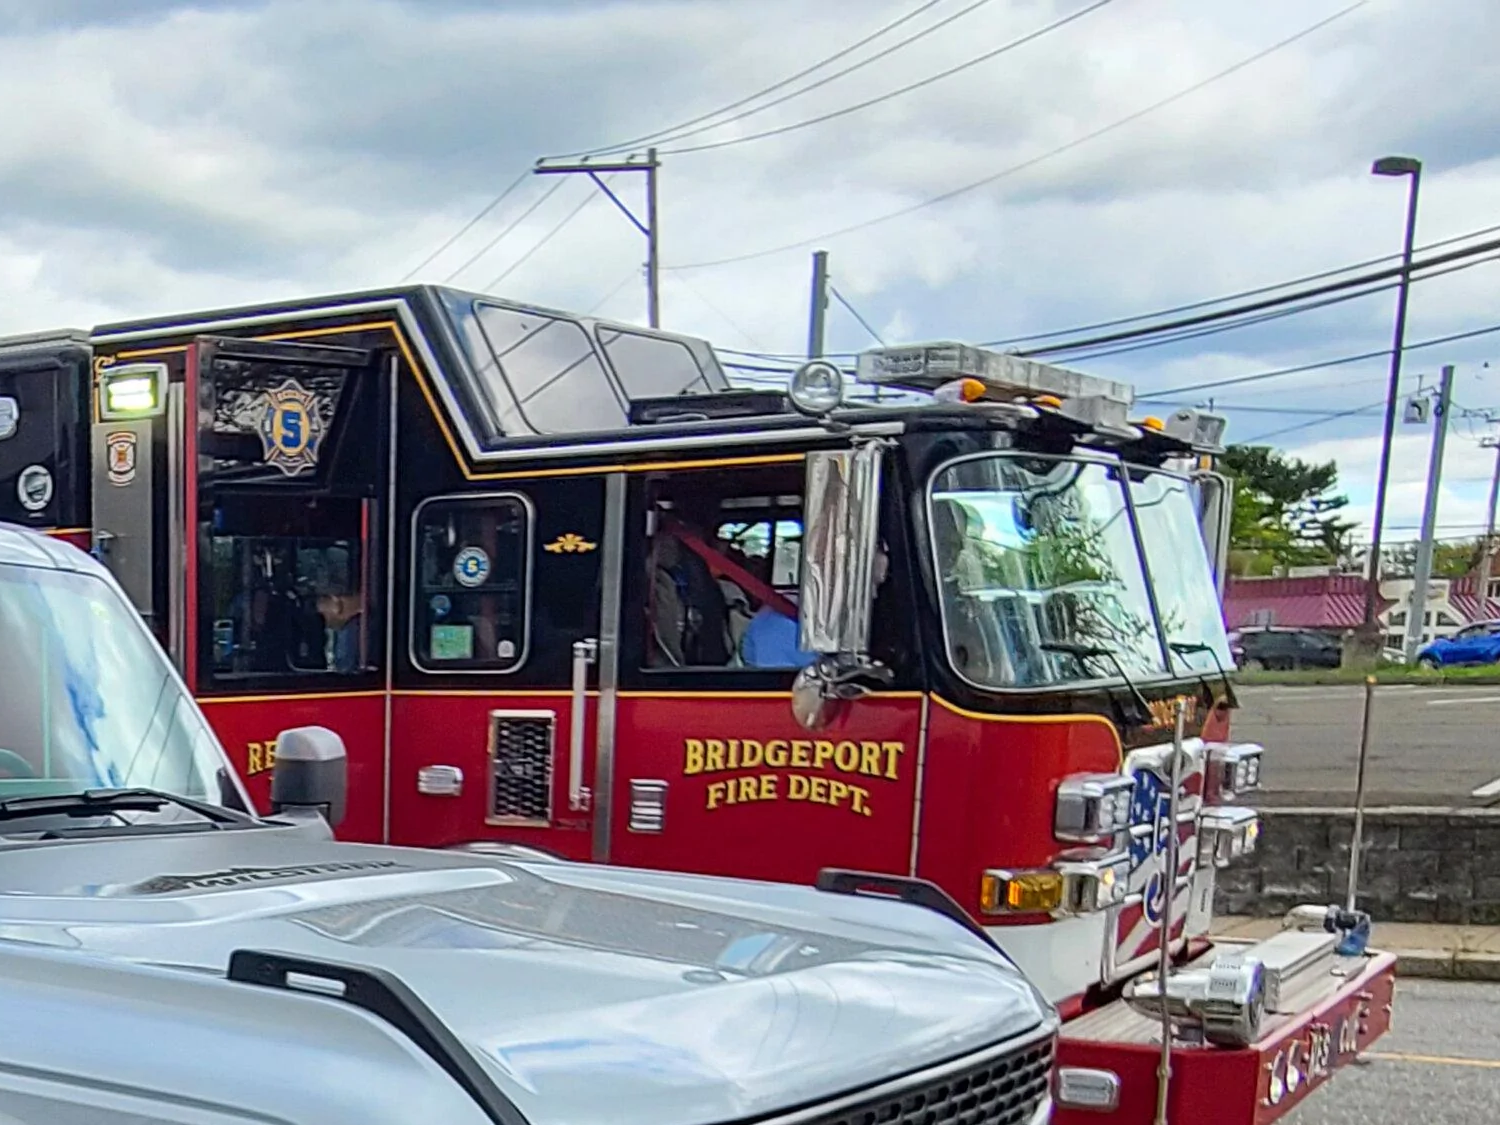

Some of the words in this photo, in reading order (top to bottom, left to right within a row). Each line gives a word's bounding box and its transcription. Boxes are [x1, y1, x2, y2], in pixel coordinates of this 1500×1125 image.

[280, 409, 302, 449] 5
[683, 738, 905, 781] BRIDGEPORT
[706, 774, 780, 810] FIRE
[787, 774, 873, 818] DEPT.
